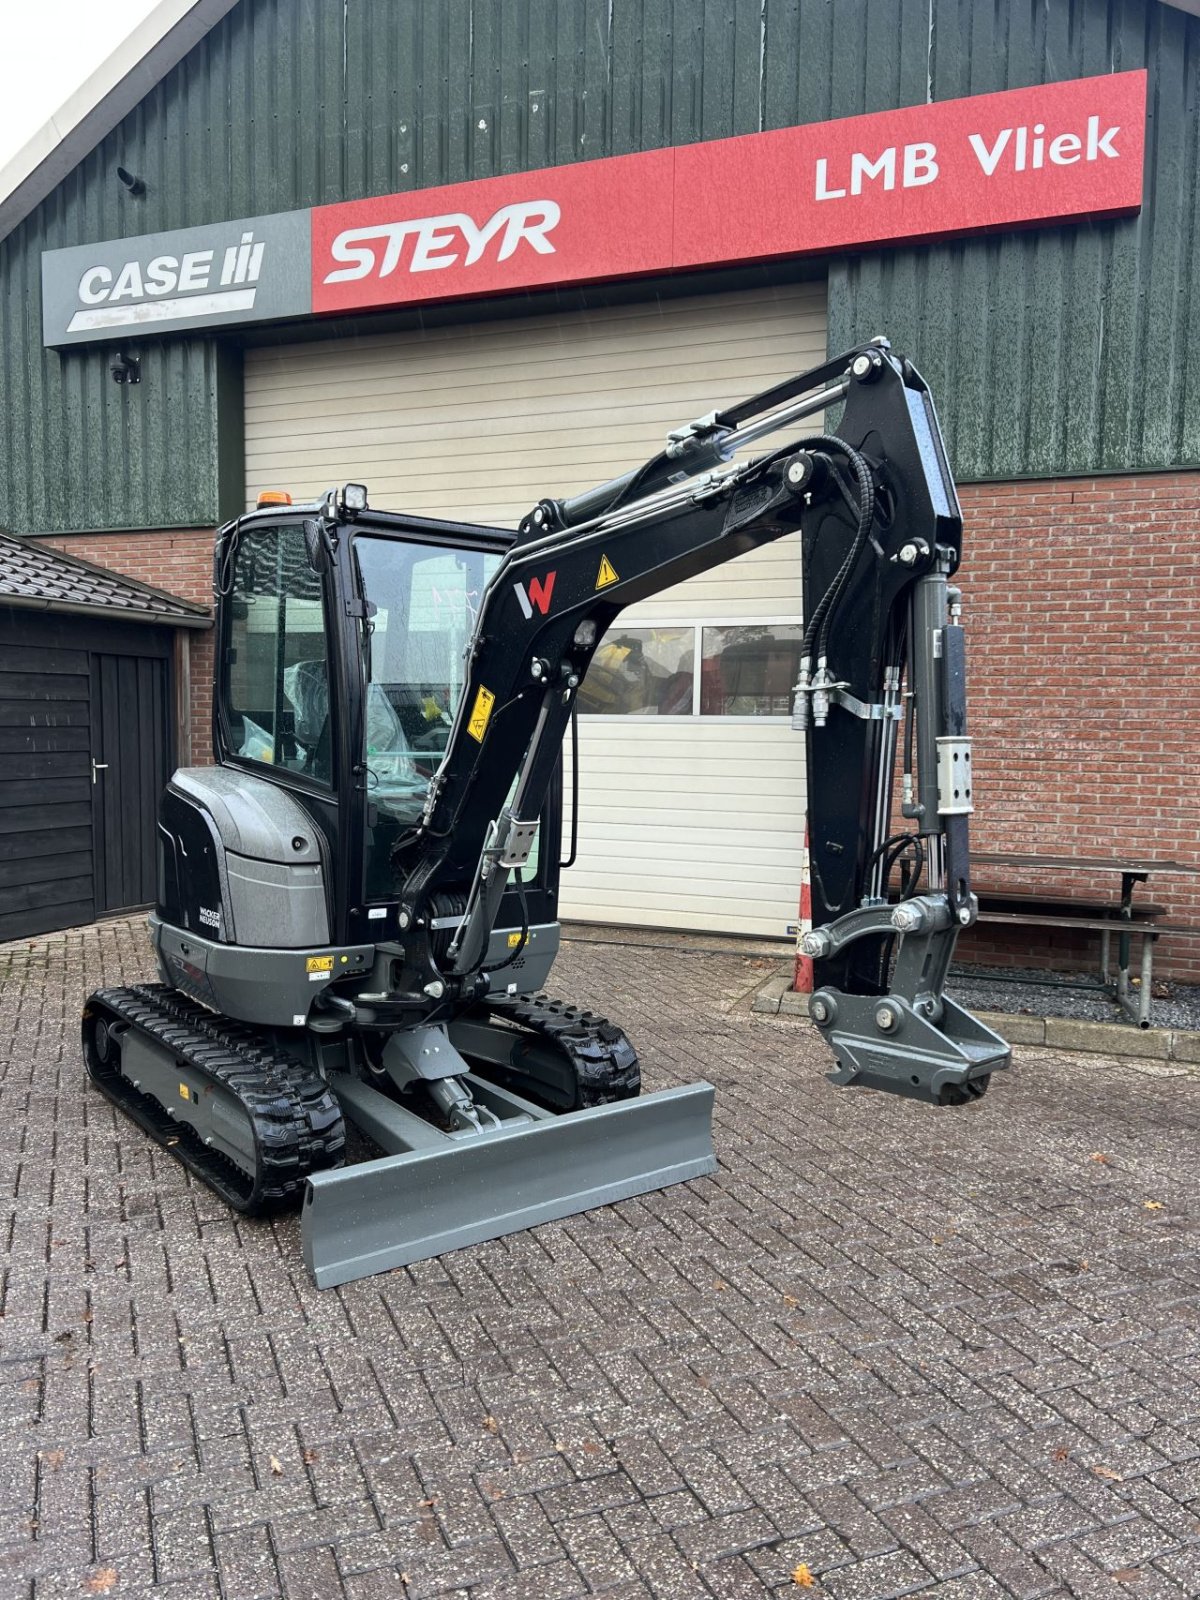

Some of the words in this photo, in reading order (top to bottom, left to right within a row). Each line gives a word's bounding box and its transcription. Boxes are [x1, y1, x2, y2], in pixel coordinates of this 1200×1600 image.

[815, 142, 939, 201] LMB
[968, 115, 1121, 176] Vliek
[78, 250, 214, 304] CASE
[322, 199, 562, 284] STEYR
